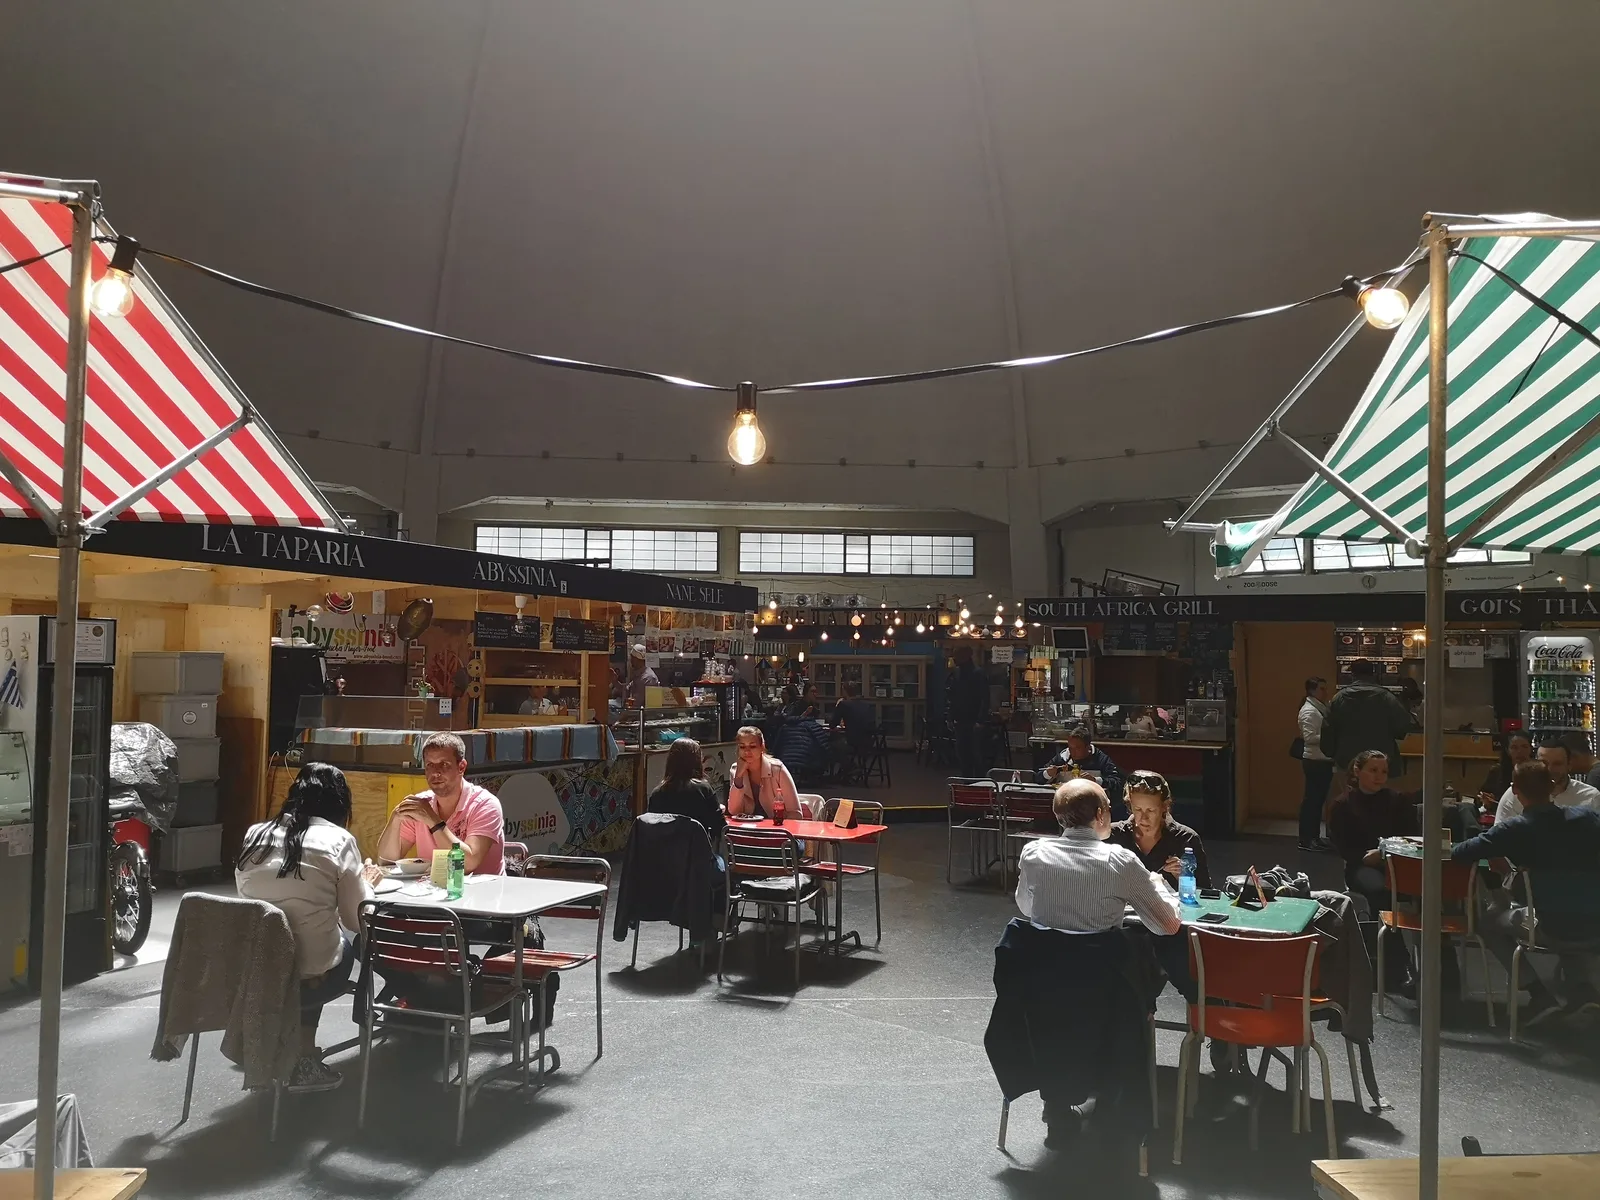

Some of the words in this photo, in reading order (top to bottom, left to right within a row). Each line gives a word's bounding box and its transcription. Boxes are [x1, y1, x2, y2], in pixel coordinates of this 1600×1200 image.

[202, 524, 243, 555] LA
[254, 531, 366, 568] TAPARIA
[473, 560, 557, 588] ABYSSINIA
[666, 582, 697, 602] NANE
[699, 586, 725, 605] SELE
[1028, 602, 1086, 616] SOUTH
[1092, 601, 1158, 616] AFRICA
[1163, 600, 1220, 616] GRILL
[1460, 598, 1522, 615] GOI'S
[1537, 598, 1599, 615] THA
[292, 620, 396, 648] abyssinia
[1534, 644, 1585, 659] Coca-Cola
[503, 810, 557, 839] byssinia
